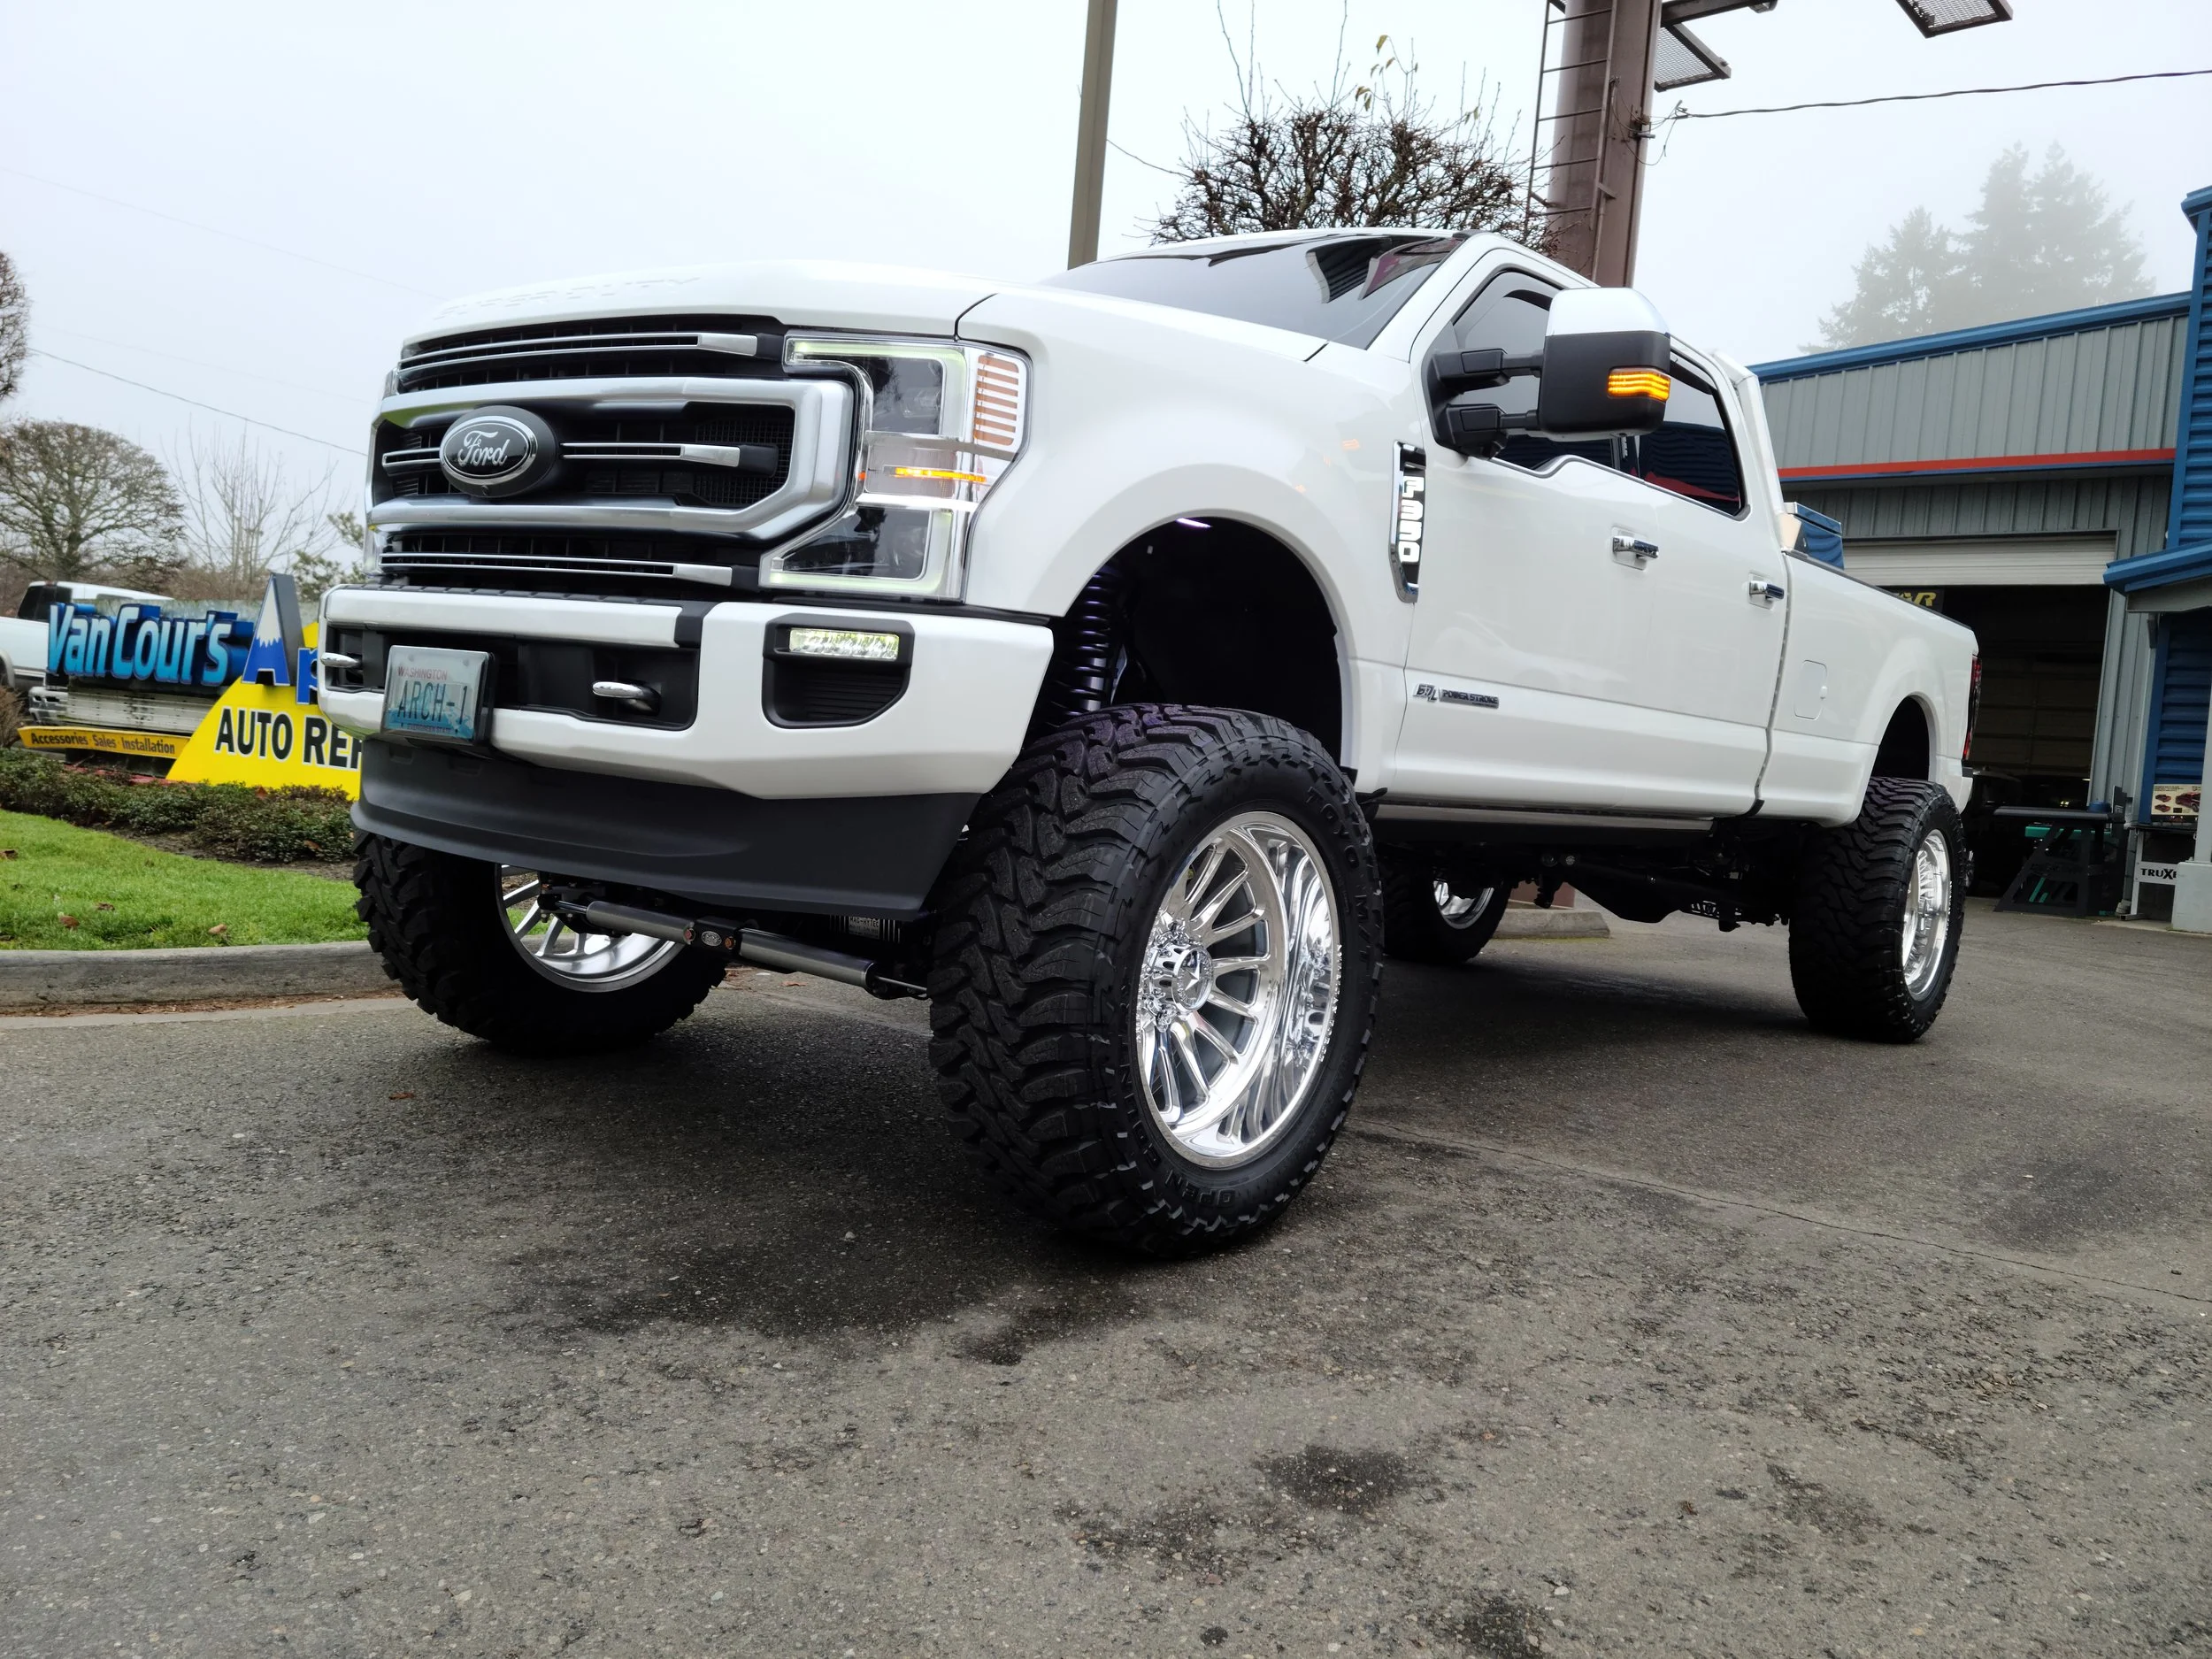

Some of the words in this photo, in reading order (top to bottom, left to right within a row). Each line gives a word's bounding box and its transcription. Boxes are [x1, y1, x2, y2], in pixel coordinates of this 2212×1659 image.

[457, 430, 511, 466] Ford
[1398, 475, 1425, 564] F350
[398, 666, 448, 680] WASHINGTON
[397, 680, 468, 725] ARCH-1
[1442, 689, 1469, 700] POWER
[1469, 693, 1498, 704] STROKE
[31, 733, 88, 745] Accessories
[93, 734, 116, 749] Sales
[122, 737, 174, 754] Installation
[215, 708, 293, 760] AUTO
